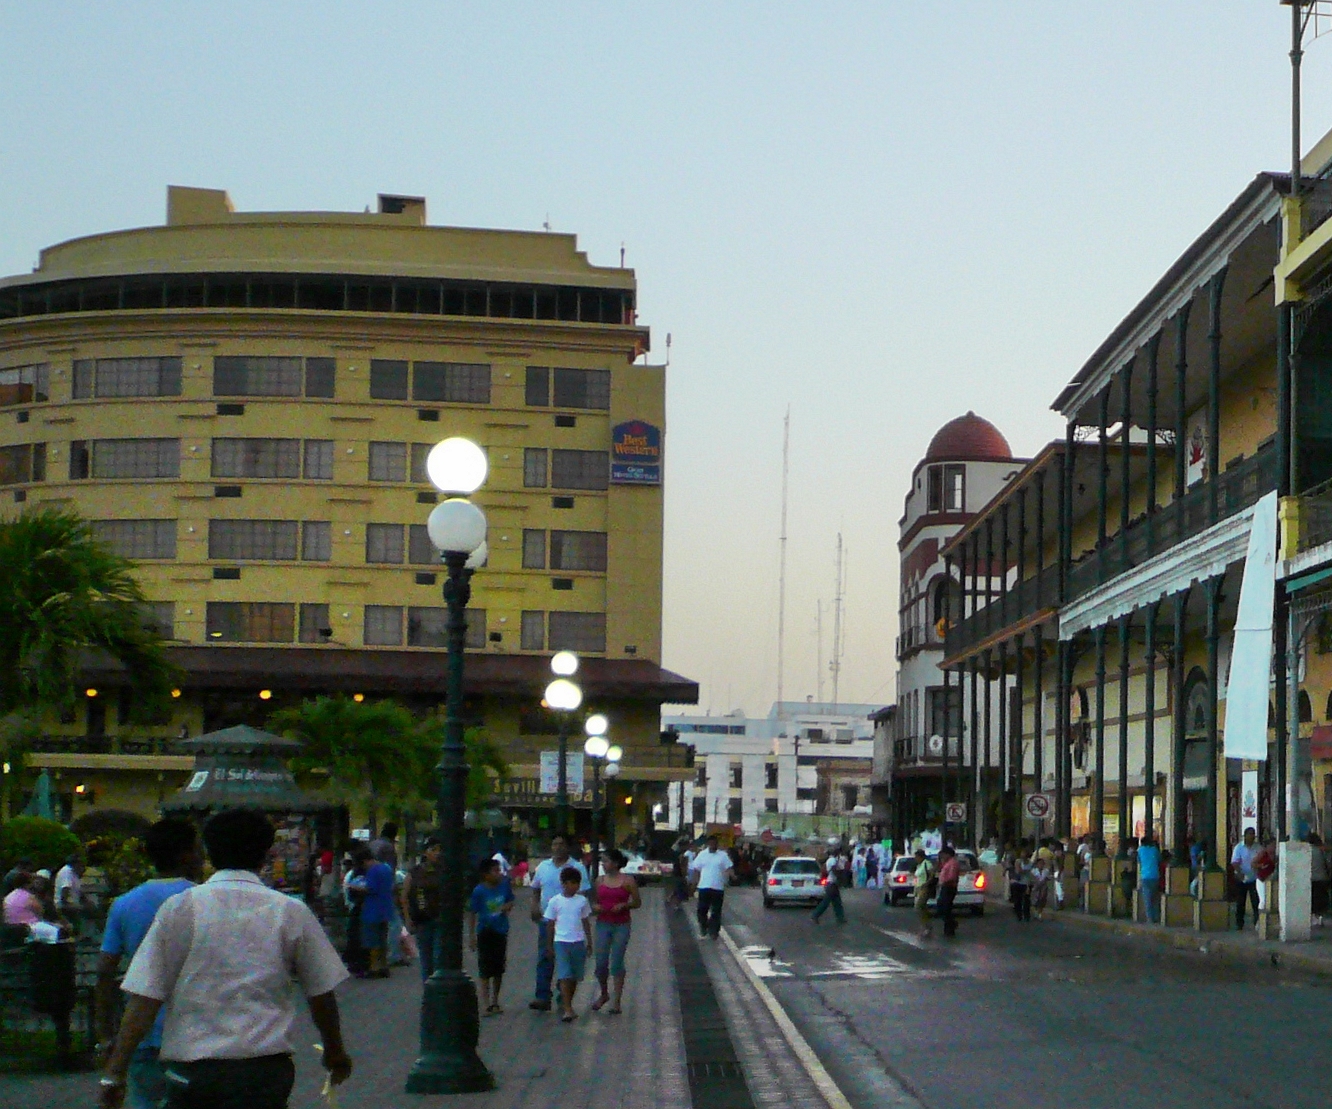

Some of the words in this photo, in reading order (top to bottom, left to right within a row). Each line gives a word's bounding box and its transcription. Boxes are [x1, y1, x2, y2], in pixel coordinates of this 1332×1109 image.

[624, 433, 648, 446] Best
[614, 442, 659, 456] Western
[493, 778, 542, 794] Sevill
